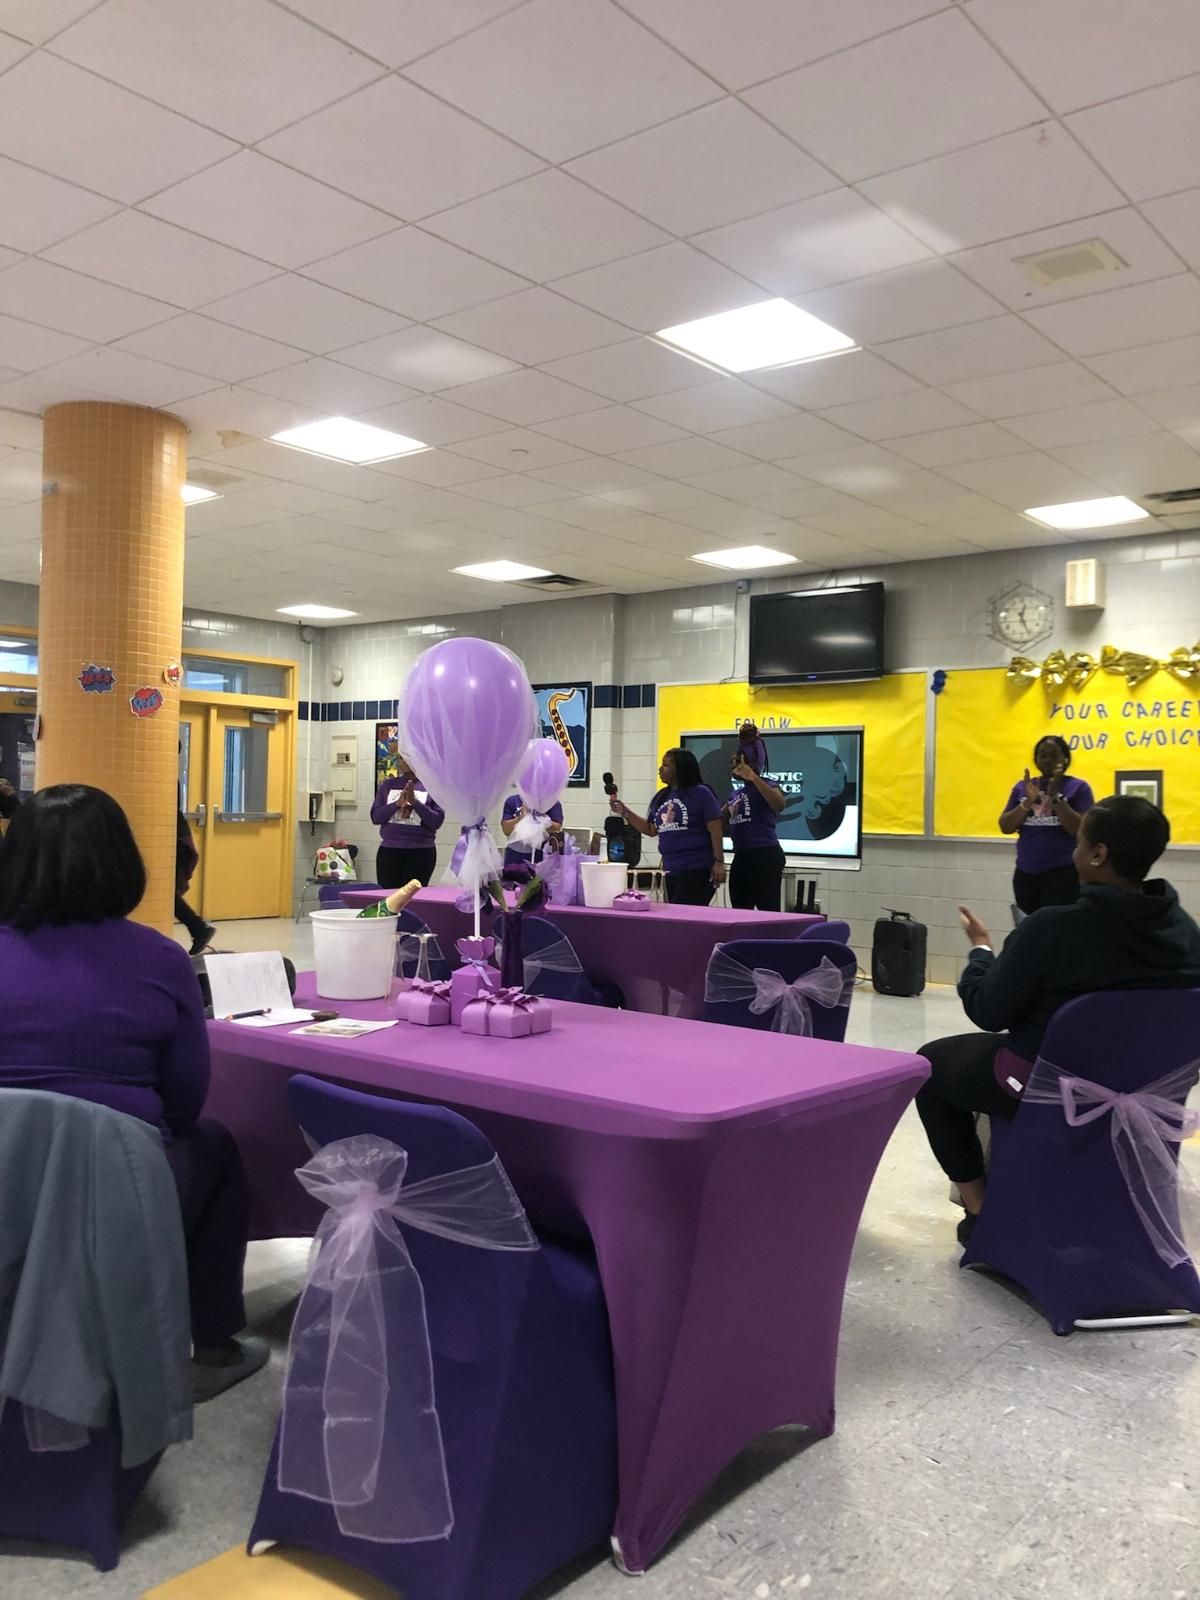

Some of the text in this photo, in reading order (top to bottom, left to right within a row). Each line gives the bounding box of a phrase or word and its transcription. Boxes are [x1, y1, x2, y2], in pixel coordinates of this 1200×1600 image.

[1049, 701, 1200, 720] YOUR CAREE
[1061, 729, 1200, 751] OUR CHOIC
